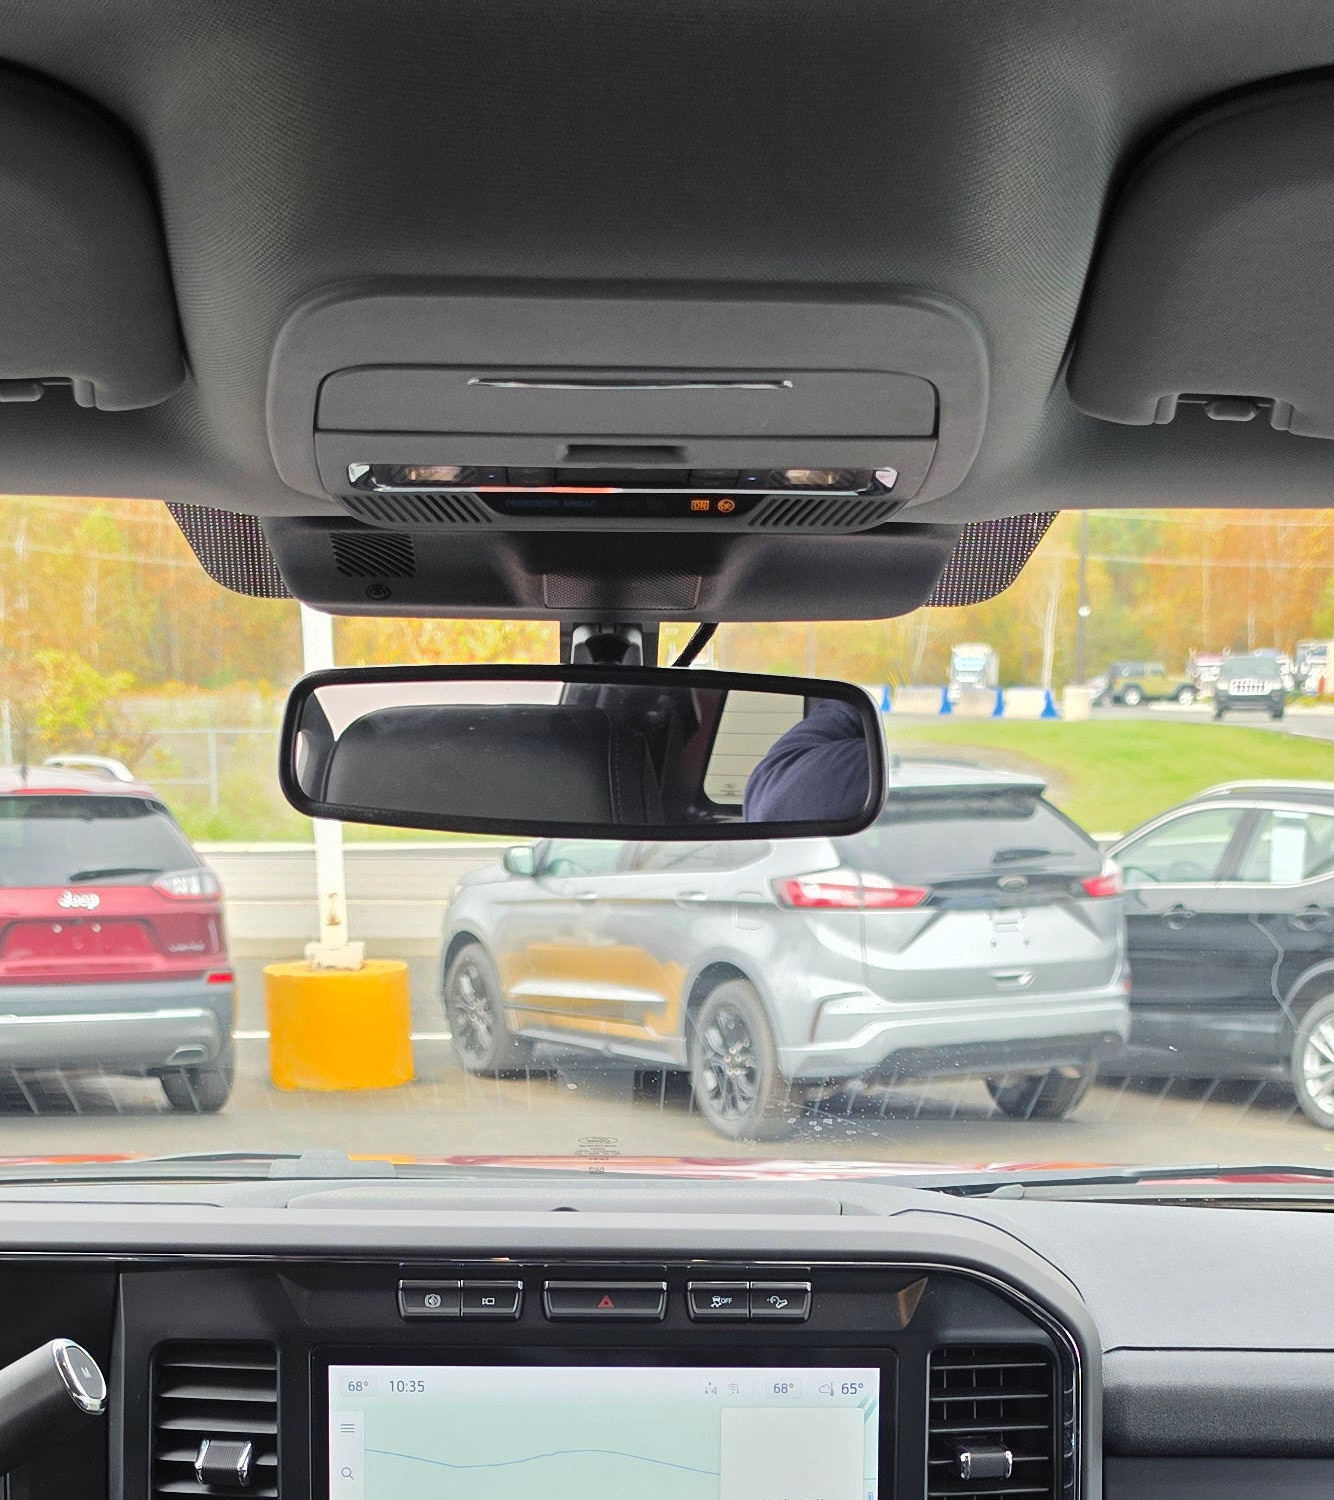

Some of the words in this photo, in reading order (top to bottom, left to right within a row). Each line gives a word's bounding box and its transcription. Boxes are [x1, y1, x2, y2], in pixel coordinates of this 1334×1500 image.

[57, 890, 101, 910] Jeep
[719, 1297, 733, 1306] OFF
[388, 1379, 426, 1394] 10:35
